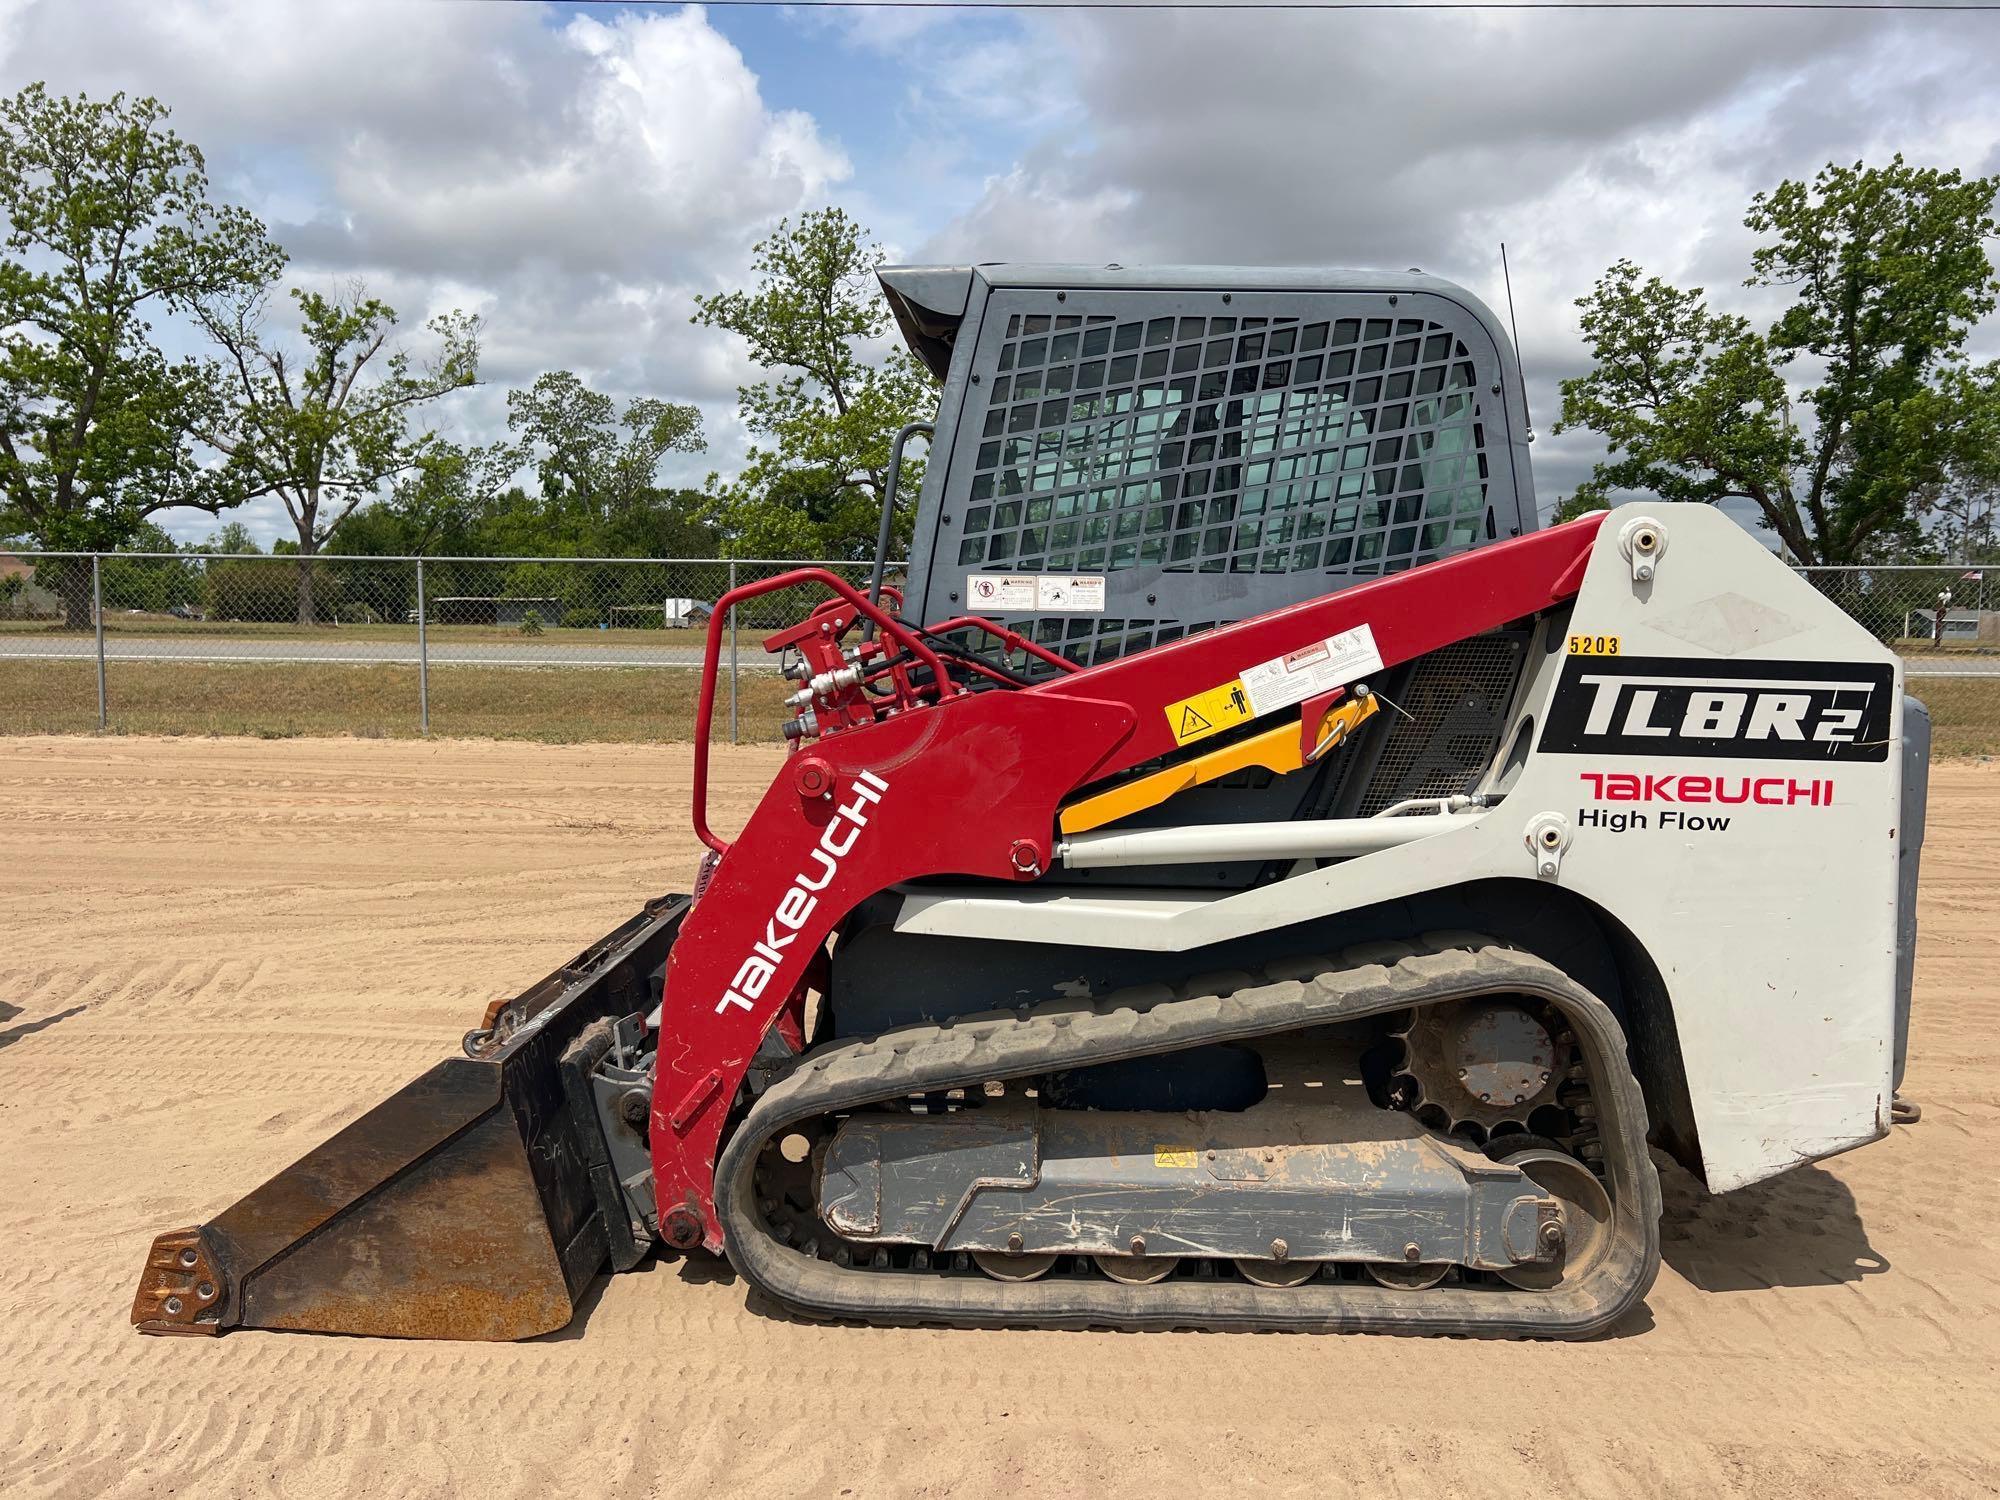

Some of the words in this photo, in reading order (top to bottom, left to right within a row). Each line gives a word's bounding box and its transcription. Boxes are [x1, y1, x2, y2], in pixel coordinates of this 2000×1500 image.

[1570, 636, 1618, 654] 5203
[1579, 674, 1876, 756] TL8R2
[1578, 808, 1648, 833] High
[1658, 811, 1731, 832] Flow
